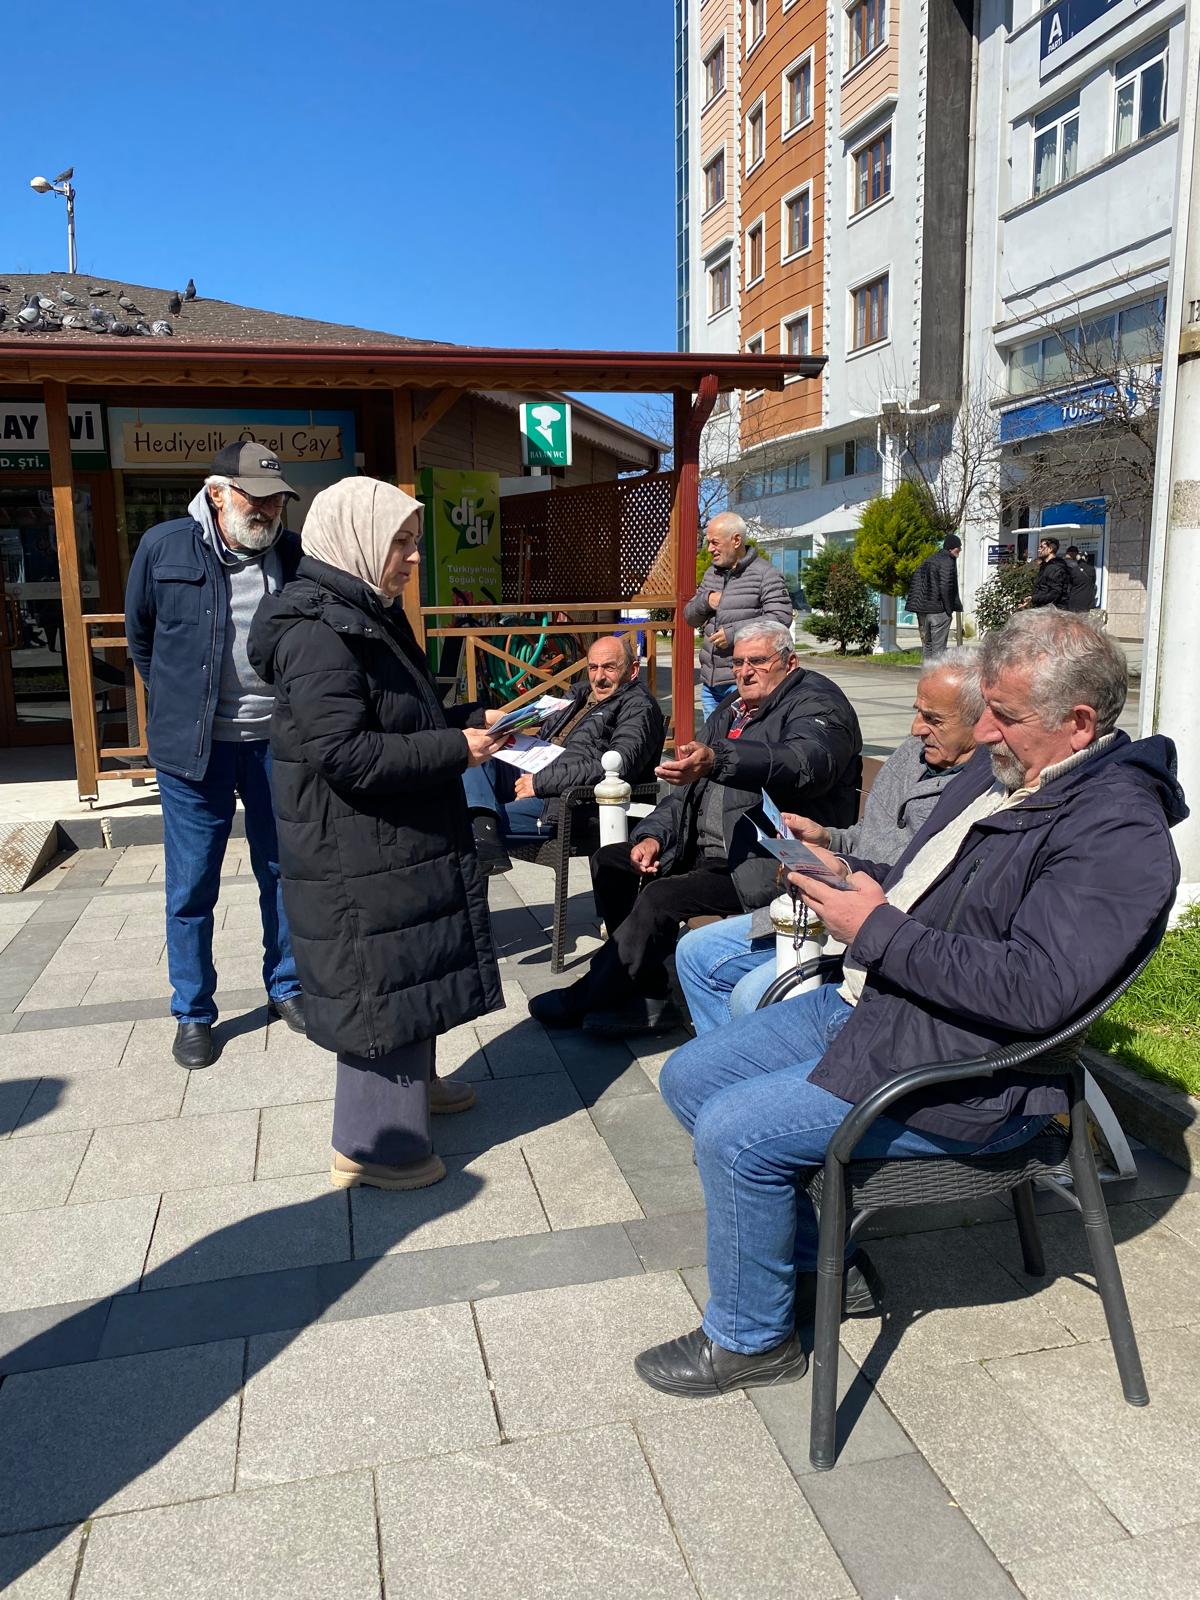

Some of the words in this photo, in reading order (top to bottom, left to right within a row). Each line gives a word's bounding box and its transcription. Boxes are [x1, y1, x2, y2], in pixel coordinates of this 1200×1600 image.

[1048, 12, 1063, 45] A
[0, 415, 39, 440] AY
[133, 431, 228, 461] Hediyelik
[291, 431, 332, 459] Çay
[530, 450, 552, 460] BAYAN
[553, 450, 565, 460] WC
[18, 455, 44, 470] ŞTİ.
[448, 575, 476, 585] Soğuk
